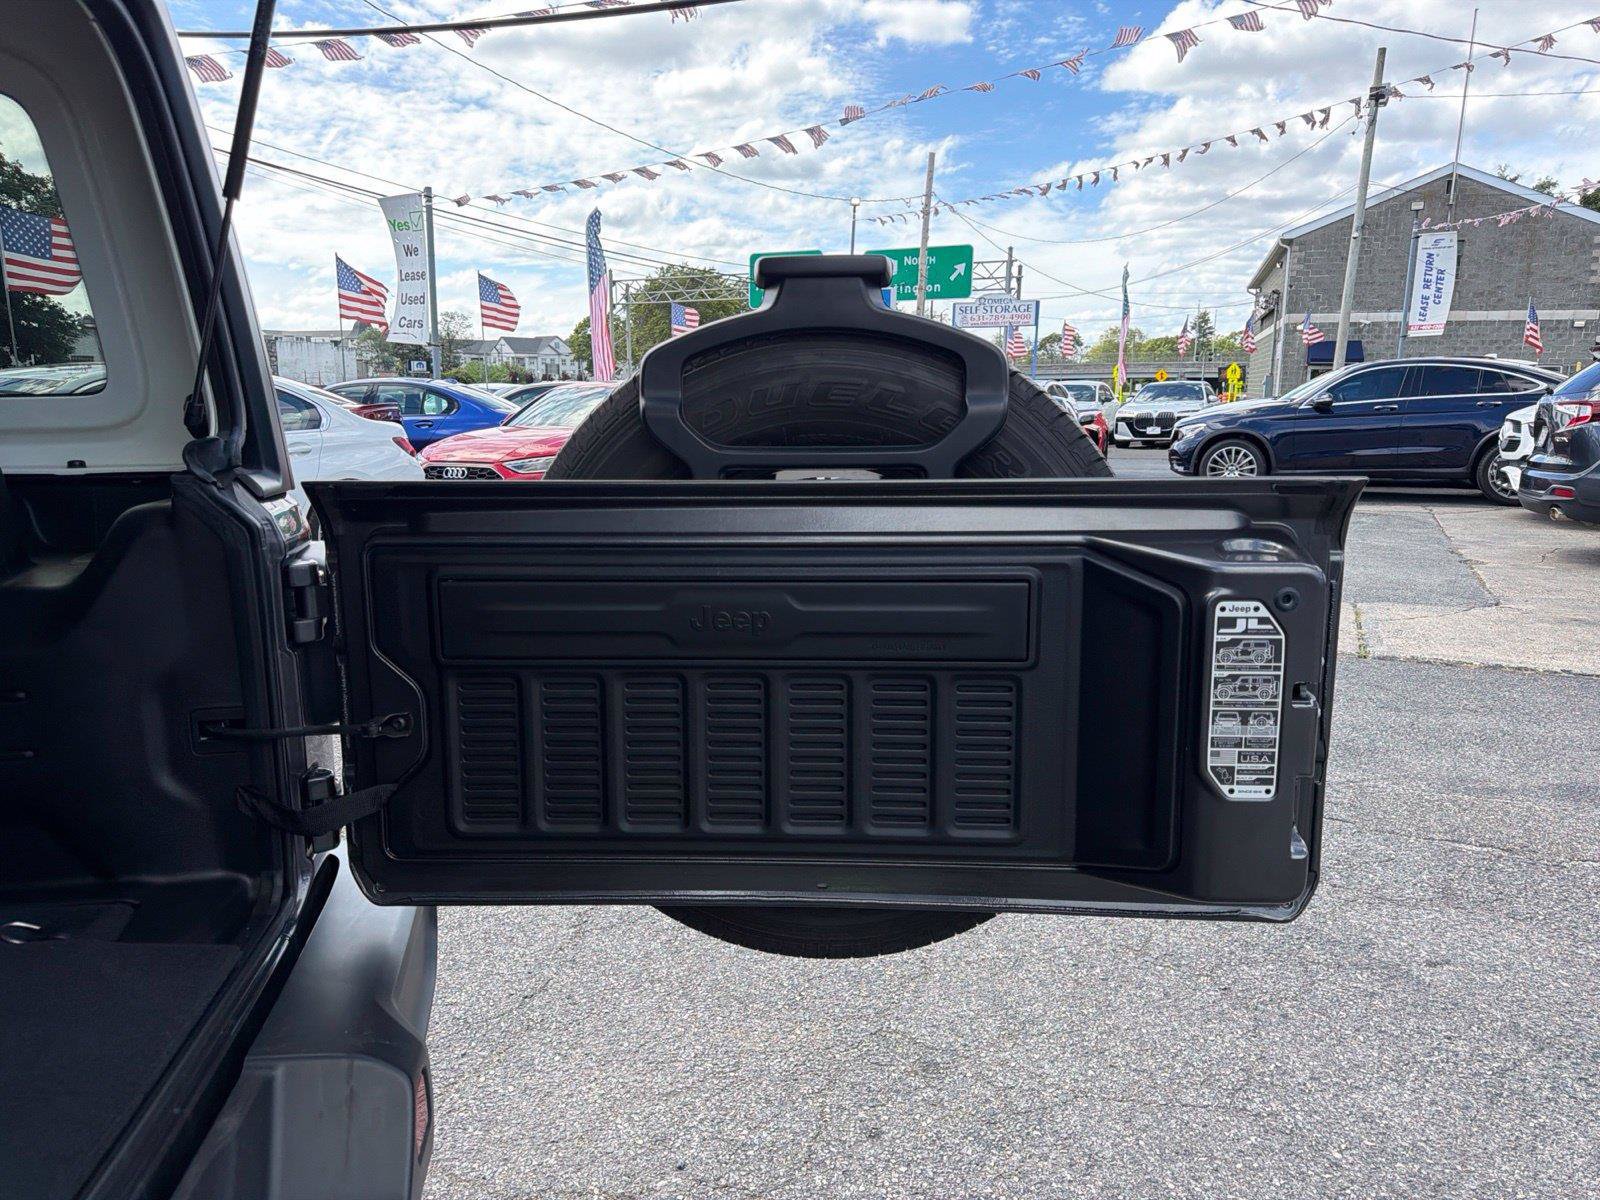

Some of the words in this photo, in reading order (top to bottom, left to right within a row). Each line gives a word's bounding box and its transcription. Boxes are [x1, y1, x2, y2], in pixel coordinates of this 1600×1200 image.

[388, 219, 411, 232] Yes
[402, 244, 419, 257] We
[903, 255, 936, 266] NOTH
[400, 269, 427, 282] Lease
[1423, 252, 1435, 290] RETURN
[1433, 268, 1446, 305] CENTER
[400, 293, 426, 305] Used
[959, 305, 981, 315] SELF
[982, 303, 1033, 314] STORAGE
[1418, 294, 1430, 322] LEASE
[398, 316, 424, 329] Cars
[970, 313, 1031, 321] 631-789-4900
[1228, 605, 1251, 613] Jeep
[690, 606, 772, 637] Jeep
[1218, 618, 1274, 633] JL
